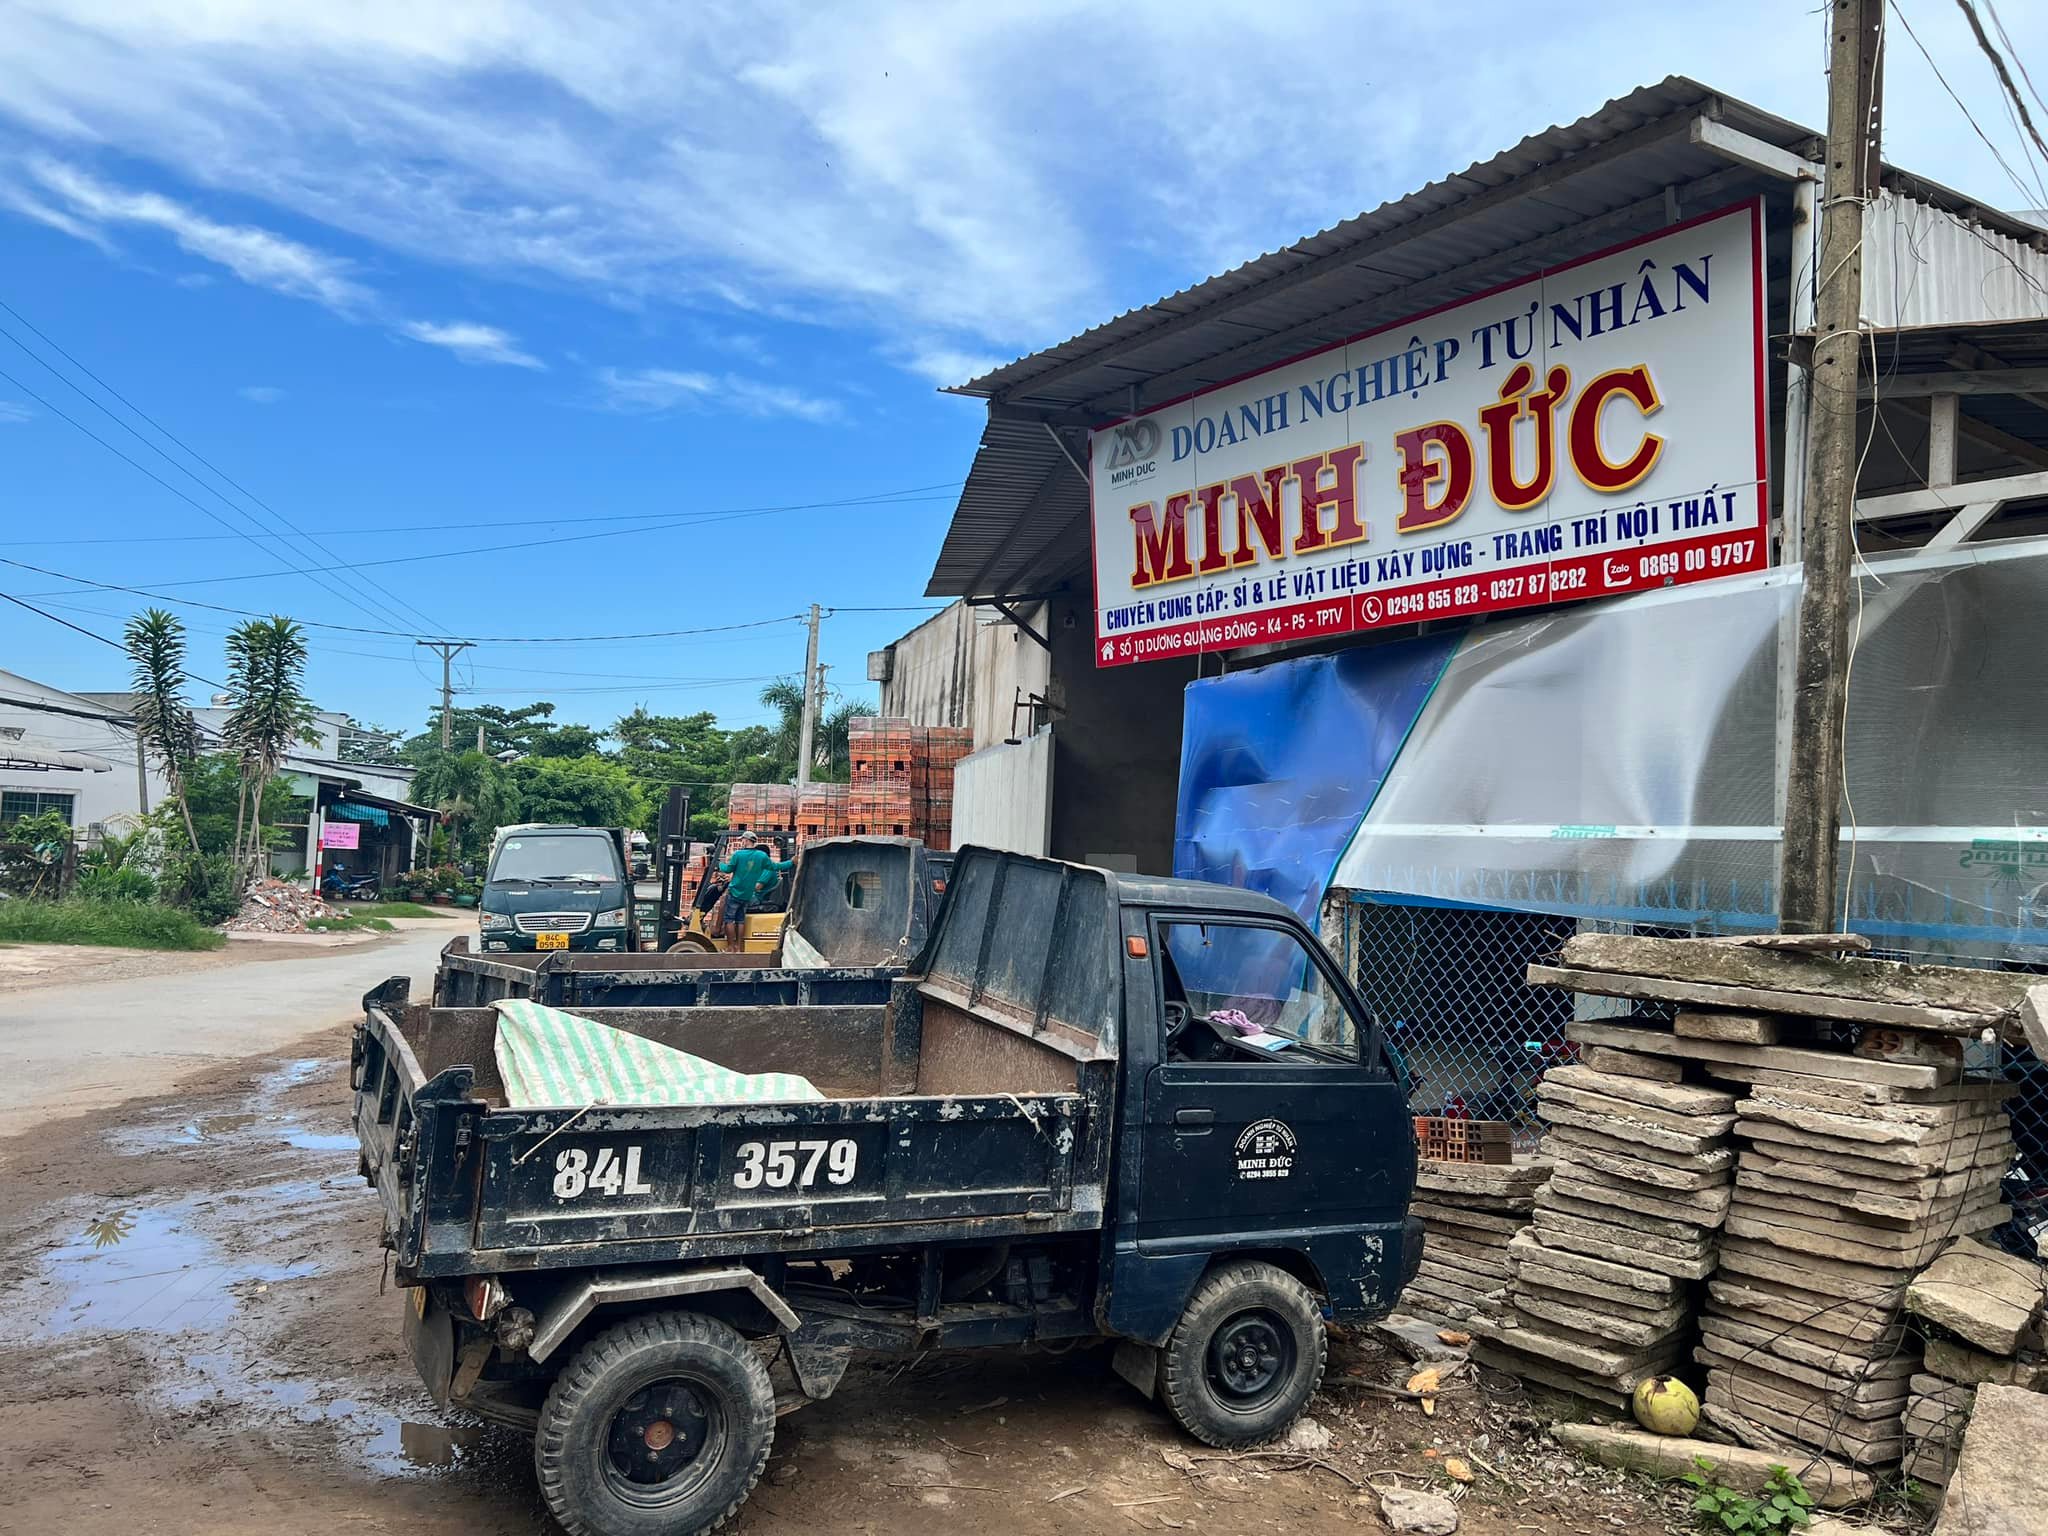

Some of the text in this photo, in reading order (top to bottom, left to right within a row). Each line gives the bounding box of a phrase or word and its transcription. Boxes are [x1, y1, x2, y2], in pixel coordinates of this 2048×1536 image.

[1171, 254, 1713, 462] DOANH NGHIỆP TƯ NHÂN
[1111, 467, 1134, 484] MINH
[1136, 461, 1156, 476] DUC
[1128, 361, 1664, 590] MINH ĐỨC
[1107, 601, 1154, 630] CHUYÊN
[1159, 595, 1192, 621] CUNG
[1196, 583, 1228, 614] CẤP:
[1234, 577, 1247, 608] SỈ
[1253, 582, 1263, 604] &
[1269, 570, 1287, 601] LẺ
[1293, 567, 1326, 600] VẬT
[1332, 558, 1370, 594] LIỆU
[1377, 550, 1415, 582] XÂY
[1422, 542, 1473, 579] DỰNG
[1493, 524, 1562, 561] TRANG
[1571, 509, 1608, 547] TRÍ
[1617, 502, 1659, 545] NỘI
[1669, 483, 1736, 531] THẤT
[1610, 540, 1755, 578] Zalo 0869 00 9797
[1387, 592, 1424, 616] 02943
[1428, 590, 1451, 610] 855
[1455, 584, 1479, 605] 828
[1491, 577, 1524, 600] 0327
[1529, 573, 1546, 594] 87
[1551, 566, 1587, 591] 8282
[1120, 636, 1132, 657] SỐ
[1135, 639, 1145, 654] 10
[1225, 620, 1257, 641] ĐÔNG
[1267, 618, 1281, 634] K4
[1292, 614, 1306, 630] P5
[1317, 607, 1343, 626] TPTV
[1238, 1156, 1292, 1169] MINH ĐỨC
[1239, 1129, 1255, 1149] DOANH
[552, 1139, 857, 1199] 84L 3579
